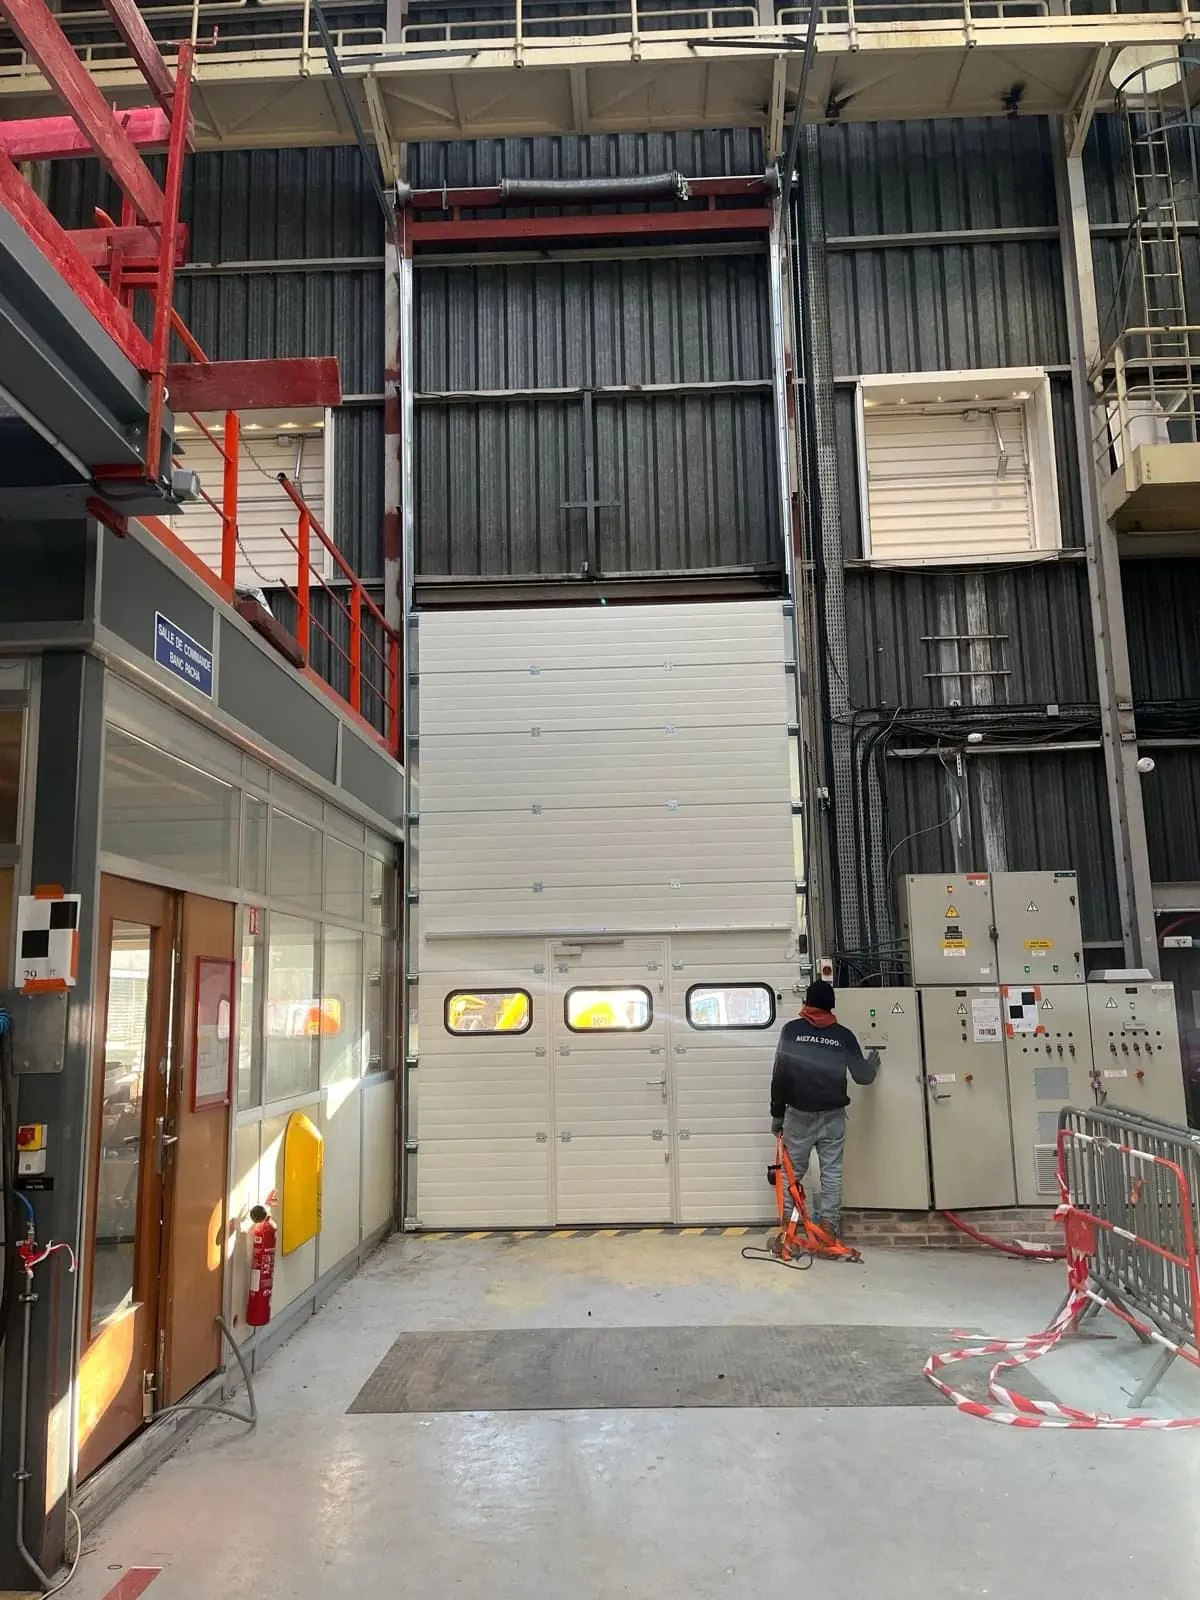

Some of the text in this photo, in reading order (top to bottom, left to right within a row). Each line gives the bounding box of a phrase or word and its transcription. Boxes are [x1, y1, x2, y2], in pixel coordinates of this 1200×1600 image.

[158, 623, 212, 672] SALLE DE COMMANDE
[169, 651, 201, 682] BANC PACHA
[795, 1034, 820, 1043] METAL
